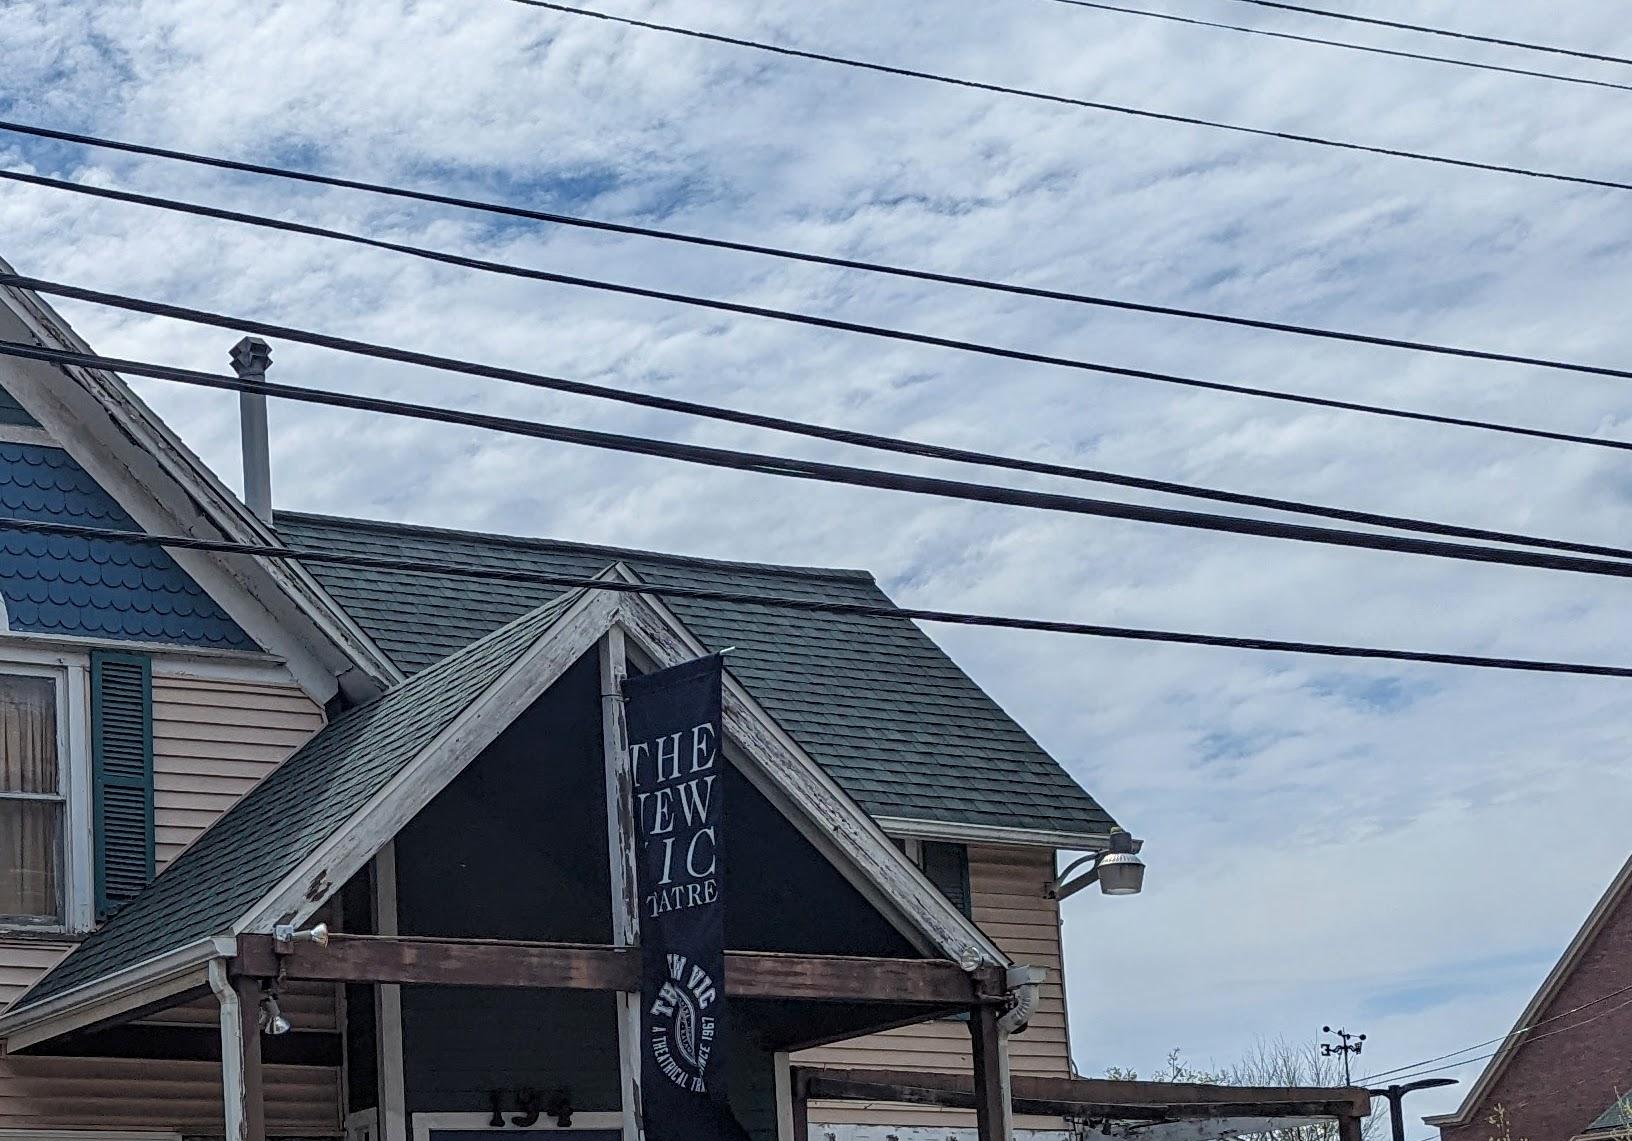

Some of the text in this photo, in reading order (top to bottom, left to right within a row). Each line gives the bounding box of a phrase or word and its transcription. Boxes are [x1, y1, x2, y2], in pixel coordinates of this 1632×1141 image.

[629, 722, 716, 787] THE
[638, 775, 717, 835] EW
[645, 826, 716, 885] IC
[651, 1035, 688, 1088] THEATRICAL
[701, 1016, 715, 1041] 1967
